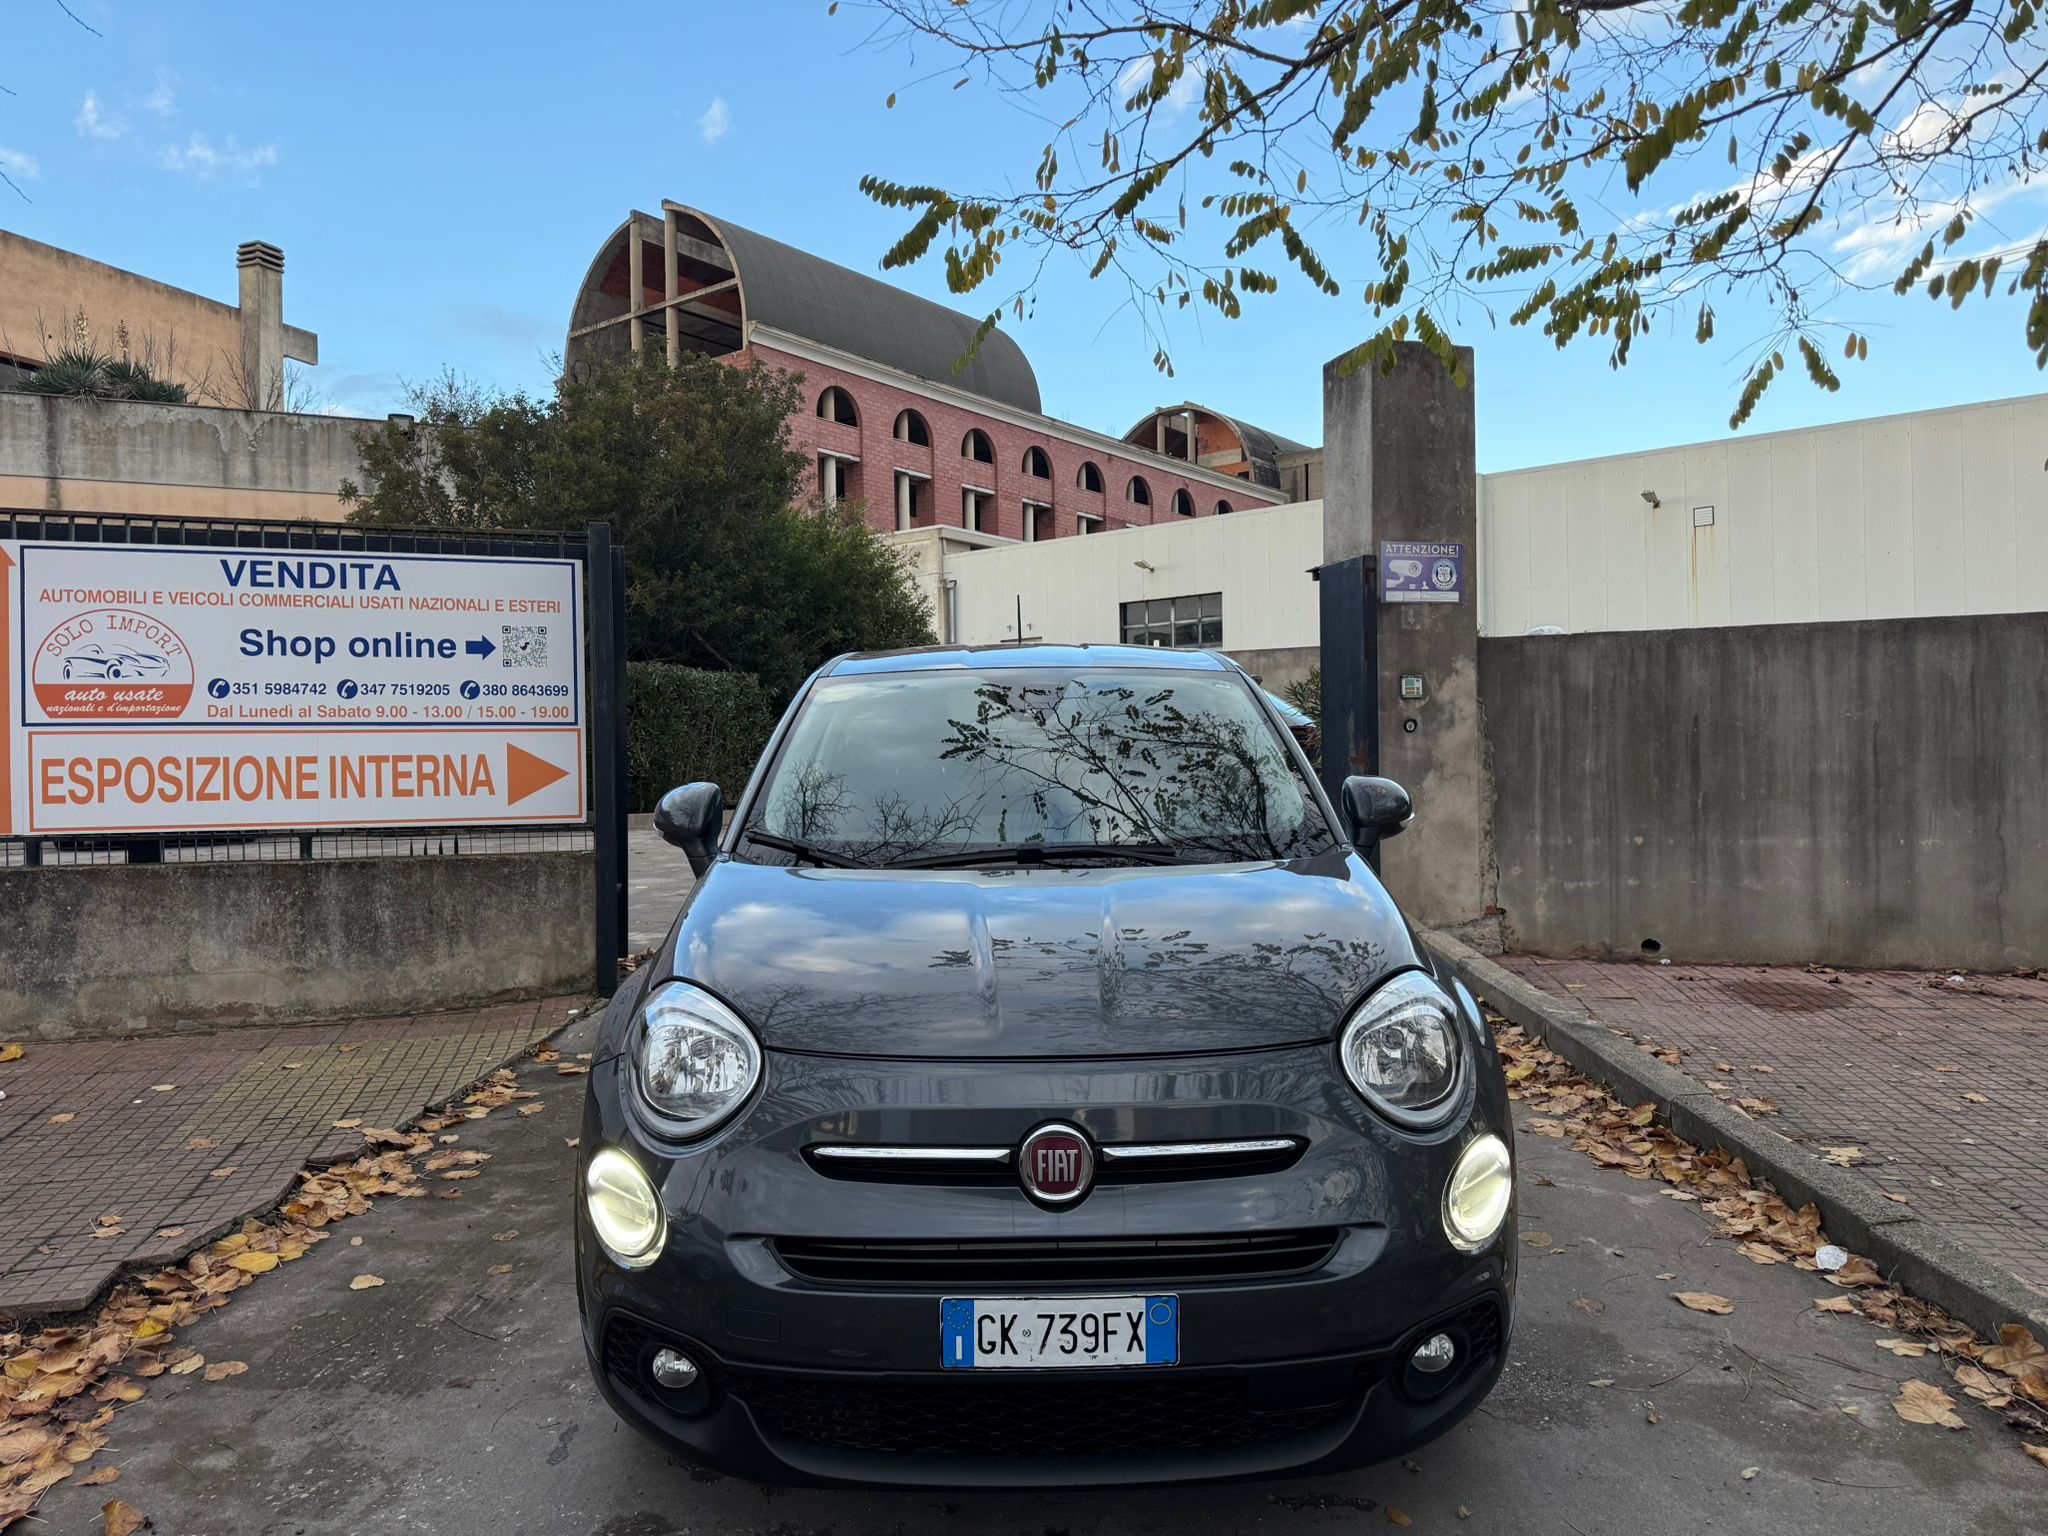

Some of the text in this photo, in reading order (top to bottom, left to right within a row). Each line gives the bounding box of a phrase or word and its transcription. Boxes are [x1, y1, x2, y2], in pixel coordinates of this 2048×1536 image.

[1385, 544, 1459, 555] ATTENZIONE!
[220, 559, 401, 591] VENDITA
[39, 588, 561, 613] AUTOMOBILI E VEICOLI COMMERCIALI USATI NAZIONALI E ESTERI
[46, 614, 182, 658] SOLO IMPORT
[239, 628, 457, 664] Shop online
[64, 687, 164, 701] auto usate
[232, 682, 327, 695] 351 5984742
[360, 683, 450, 696] 347 7519205
[482, 684, 569, 697] 380 8643699
[46, 703, 94, 715] nazionali
[106, 701, 182, 715] d'importazione
[207, 704, 233, 718] Dal
[239, 703, 293, 718] Lunedì
[298, 705, 312, 718] al
[317, 705, 371, 718] Sabato
[376, 705, 408, 718] 9.00
[423, 706, 462, 718] 13.00
[466, 705, 473, 719] /
[477, 706, 516, 718] 15.00
[531, 706, 569, 718] 19.00
[41, 753, 496, 804] ESPOSIZIONE INTERNA
[1037, 1149, 1078, 1182] FIAT
[977, 1311, 1145, 1355] GK 739FX
